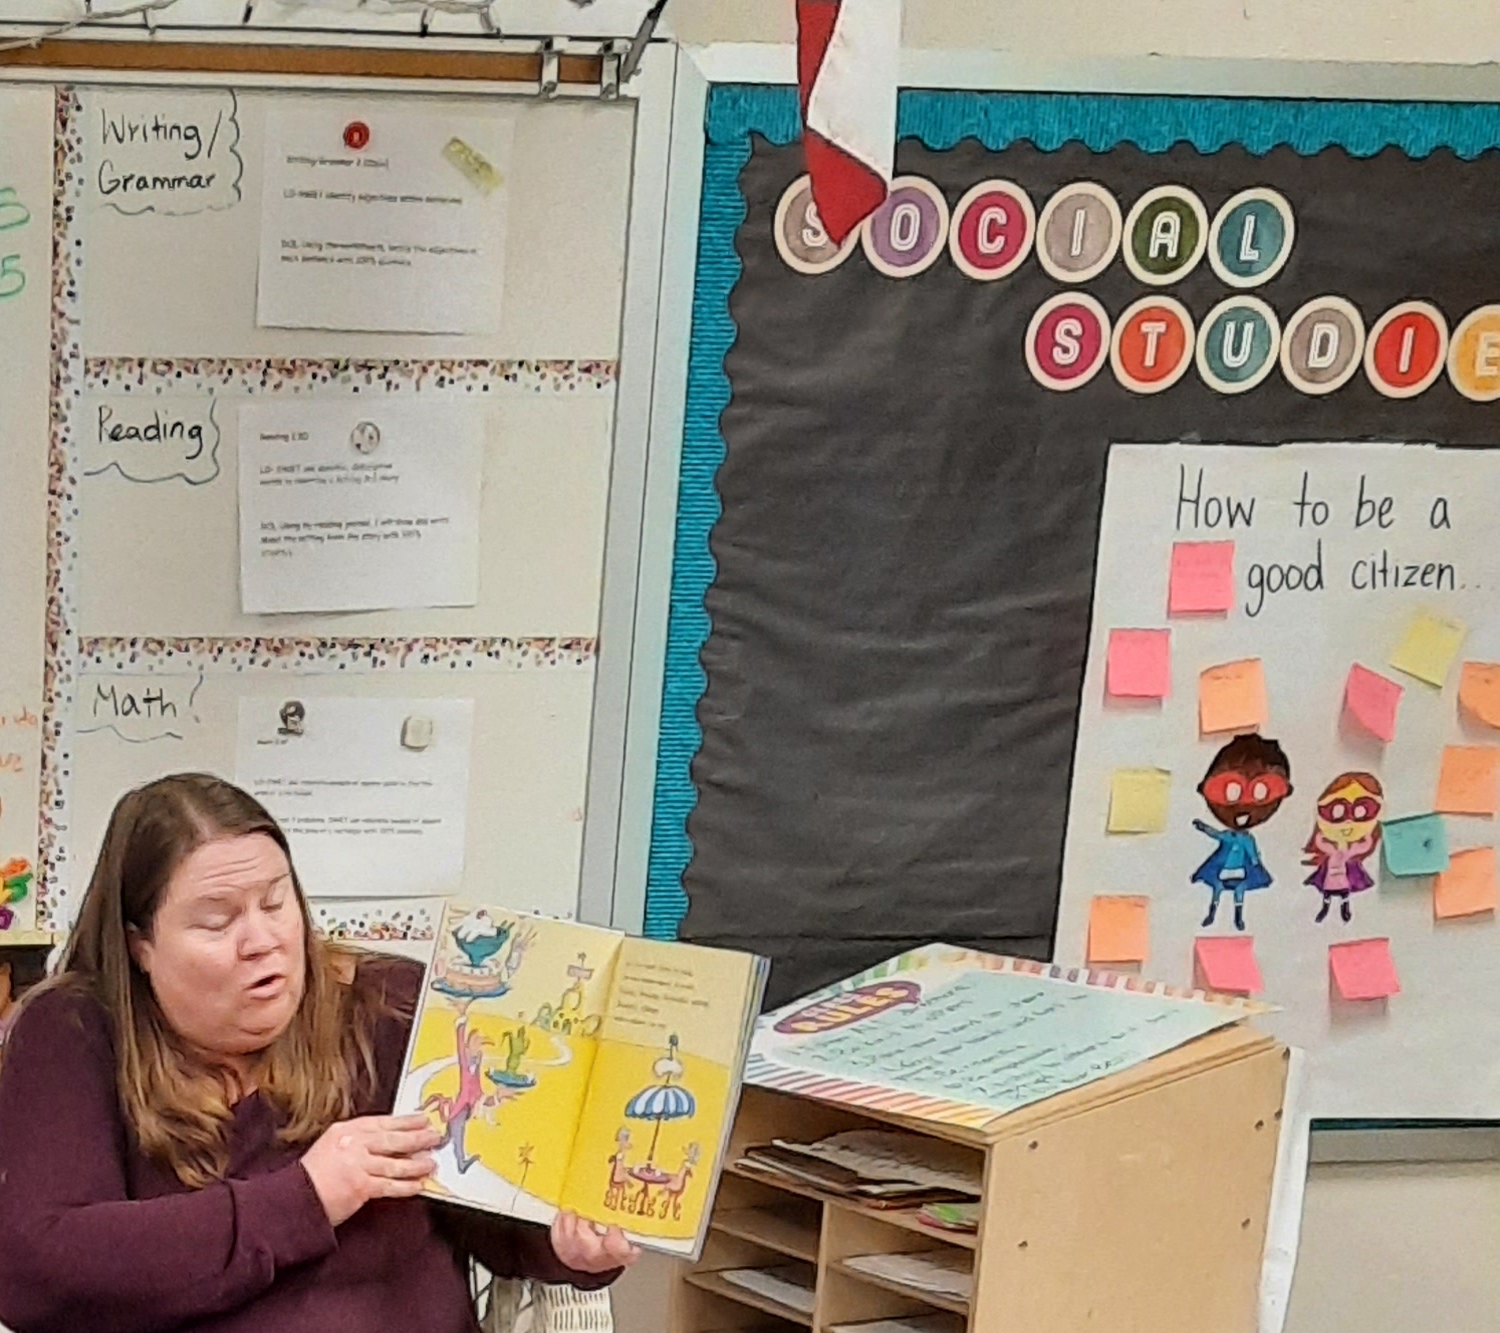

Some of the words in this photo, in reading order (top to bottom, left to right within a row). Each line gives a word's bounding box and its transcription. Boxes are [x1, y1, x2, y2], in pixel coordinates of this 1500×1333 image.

[99, 160, 217, 195] Grammar
[98, 405, 204, 460] Reading
[1176, 463, 1256, 532] How
[1294, 471, 1330, 528] to
[1354, 474, 1395, 530] be
[1429, 496, 1452, 529] a
[1245, 538, 1324, 618] good
[92, 684, 178, 721] Math
